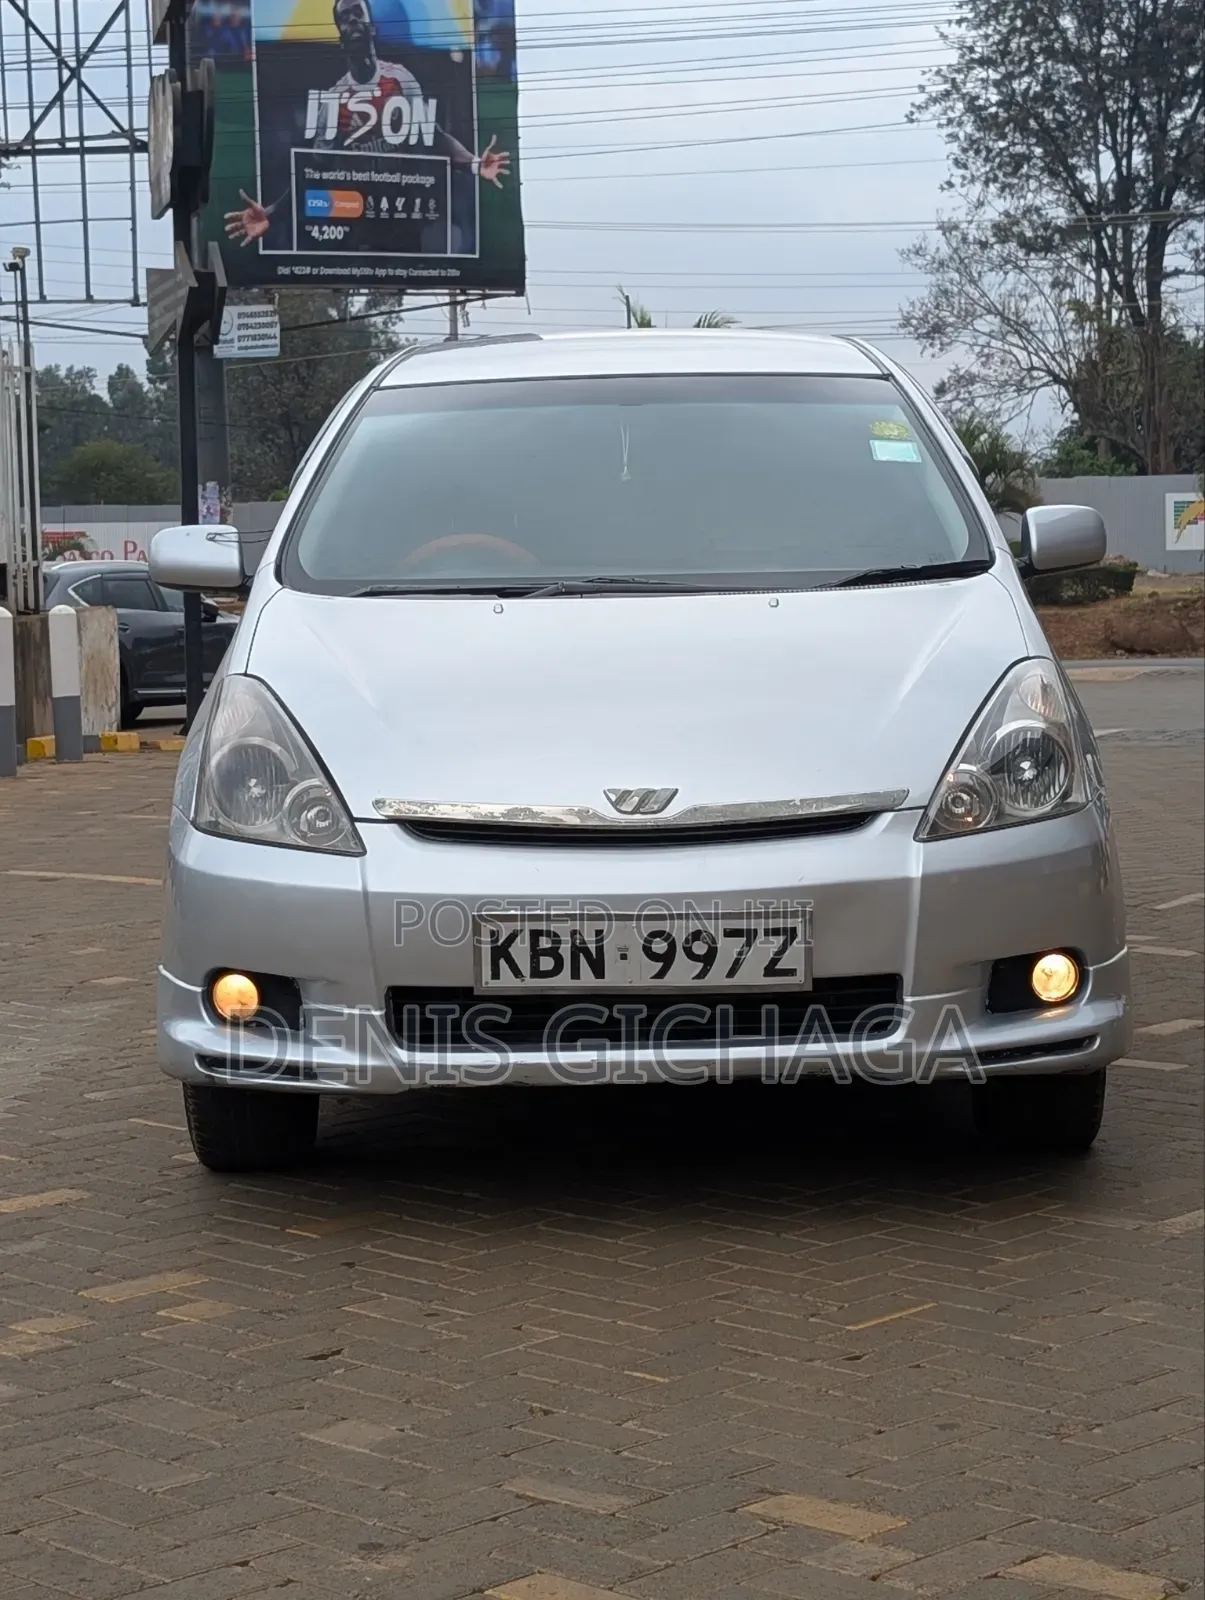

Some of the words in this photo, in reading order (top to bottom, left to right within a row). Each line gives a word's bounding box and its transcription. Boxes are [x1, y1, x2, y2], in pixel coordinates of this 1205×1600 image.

[382, 96, 437, 146] ON
[304, 168, 320, 180] The
[321, 170, 351, 181] world's
[352, 170, 370, 182] best
[371, 171, 401, 183] football
[402, 173, 436, 187] package
[312, 267, 319, 275] or
[320, 266, 350, 275] Download
[375, 267, 387, 278] App
[387, 267, 395, 276] to
[488, 928, 606, 981] KBN
[641, 926, 798, 980] 997Z
